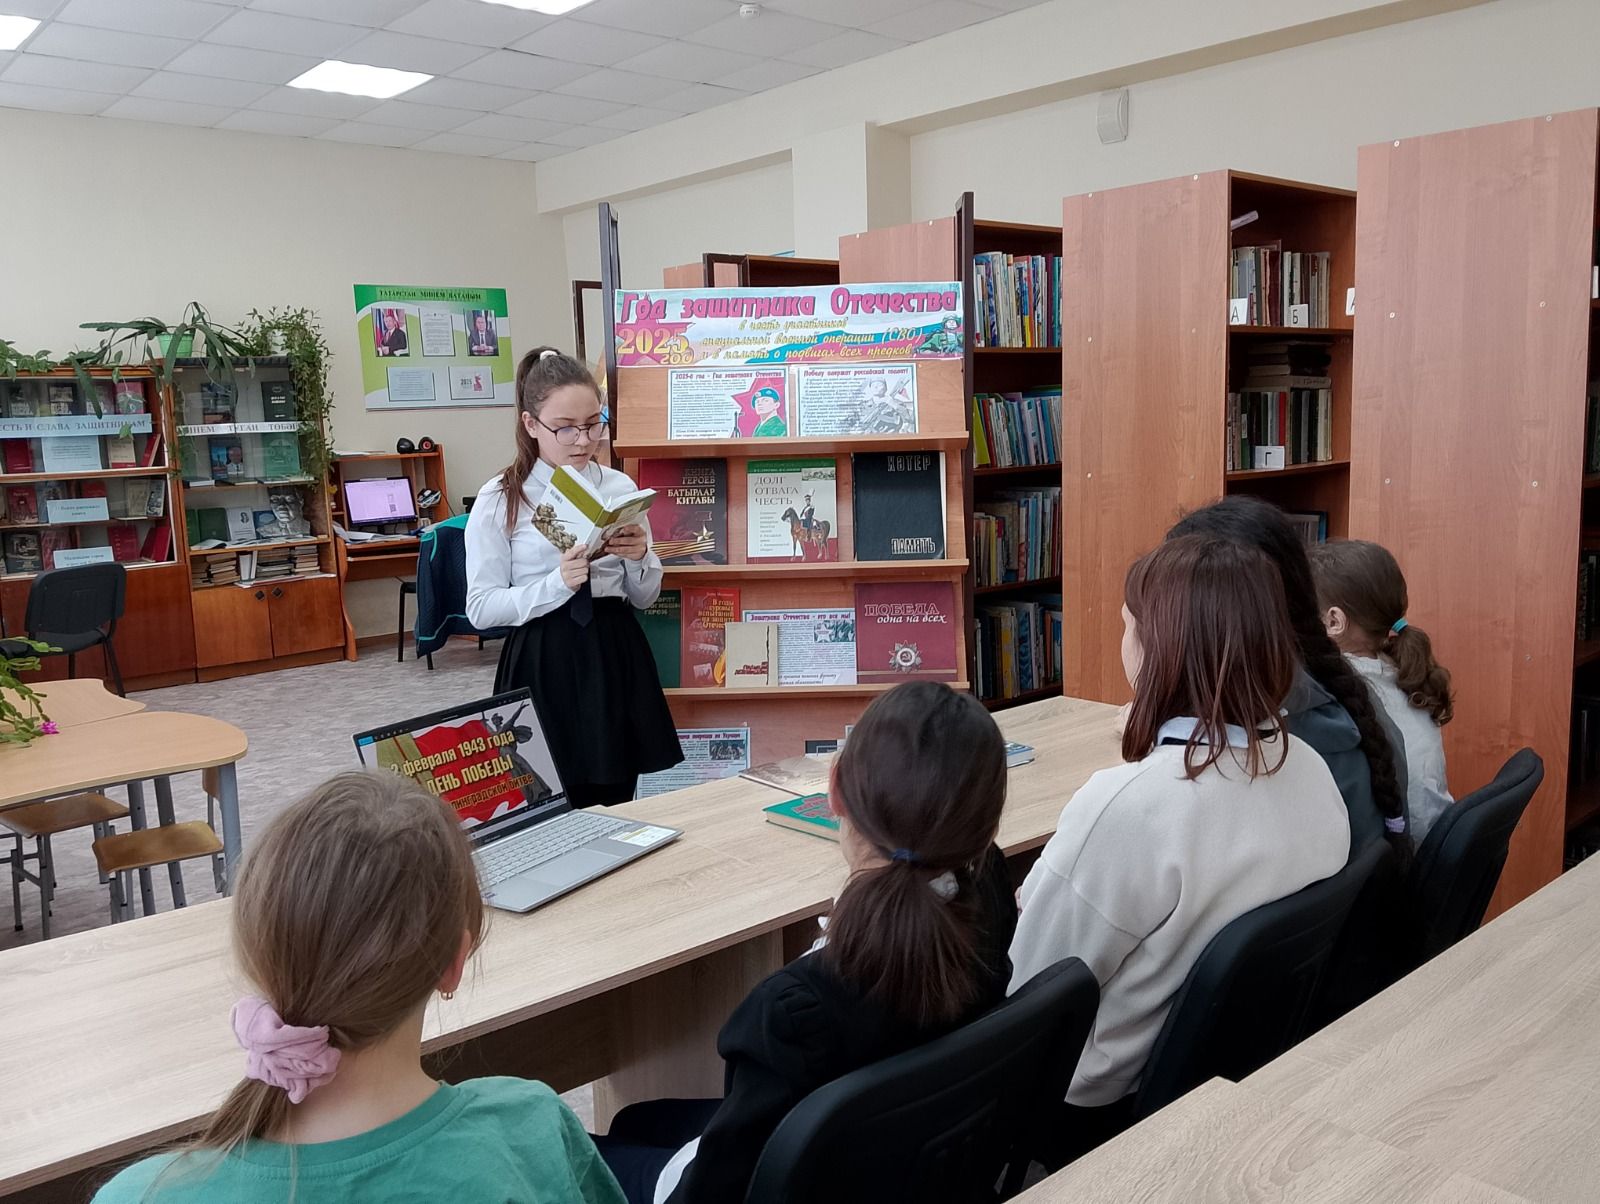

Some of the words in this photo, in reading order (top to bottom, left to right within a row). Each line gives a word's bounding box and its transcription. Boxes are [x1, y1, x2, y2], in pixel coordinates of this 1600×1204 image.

[621, 293, 667, 322] Год
[680, 296, 815, 319] защитника
[831, 287, 957, 315] Отечества
[1231, 307, 1240, 322] А
[1292, 309, 1299, 324] Б
[617, 328, 690, 354] 2025
[774, 332, 818, 345] военной
[823, 333, 875, 347] операции
[881, 327, 923, 344] (СВО)
[840, 345, 863, 357] всех
[0, 424, 22, 432] СТЬ
[37, 422, 70, 431] СЛАВА
[76, 420, 145, 430] ЗАЩИТНИАМ
[1265, 452, 1272, 466] Г
[682, 476, 715, 485] ГЕРОЕВ
[755, 476, 786, 487] ДОЛГ
[667, 488, 715, 497] БАТЫРЛАР
[755, 486, 800, 496] ОТВАГА
[676, 496, 715, 505] КИТАБЫ
[755, 496, 793, 506] ЧЕСТЬ
[864, 603, 940, 617] ПОБЕДА
[877, 614, 903, 624] одна
[905, 614, 919, 623] на
[923, 613, 947, 624] всех
[403, 749, 457, 778] февраля
[458, 738, 486, 758] 1943
[488, 730, 515, 749] года
[426, 772, 460, 796] ДЕНЬ
[461, 755, 514, 785] ПОБЕДЫ
[451, 781, 508, 810] линградской
